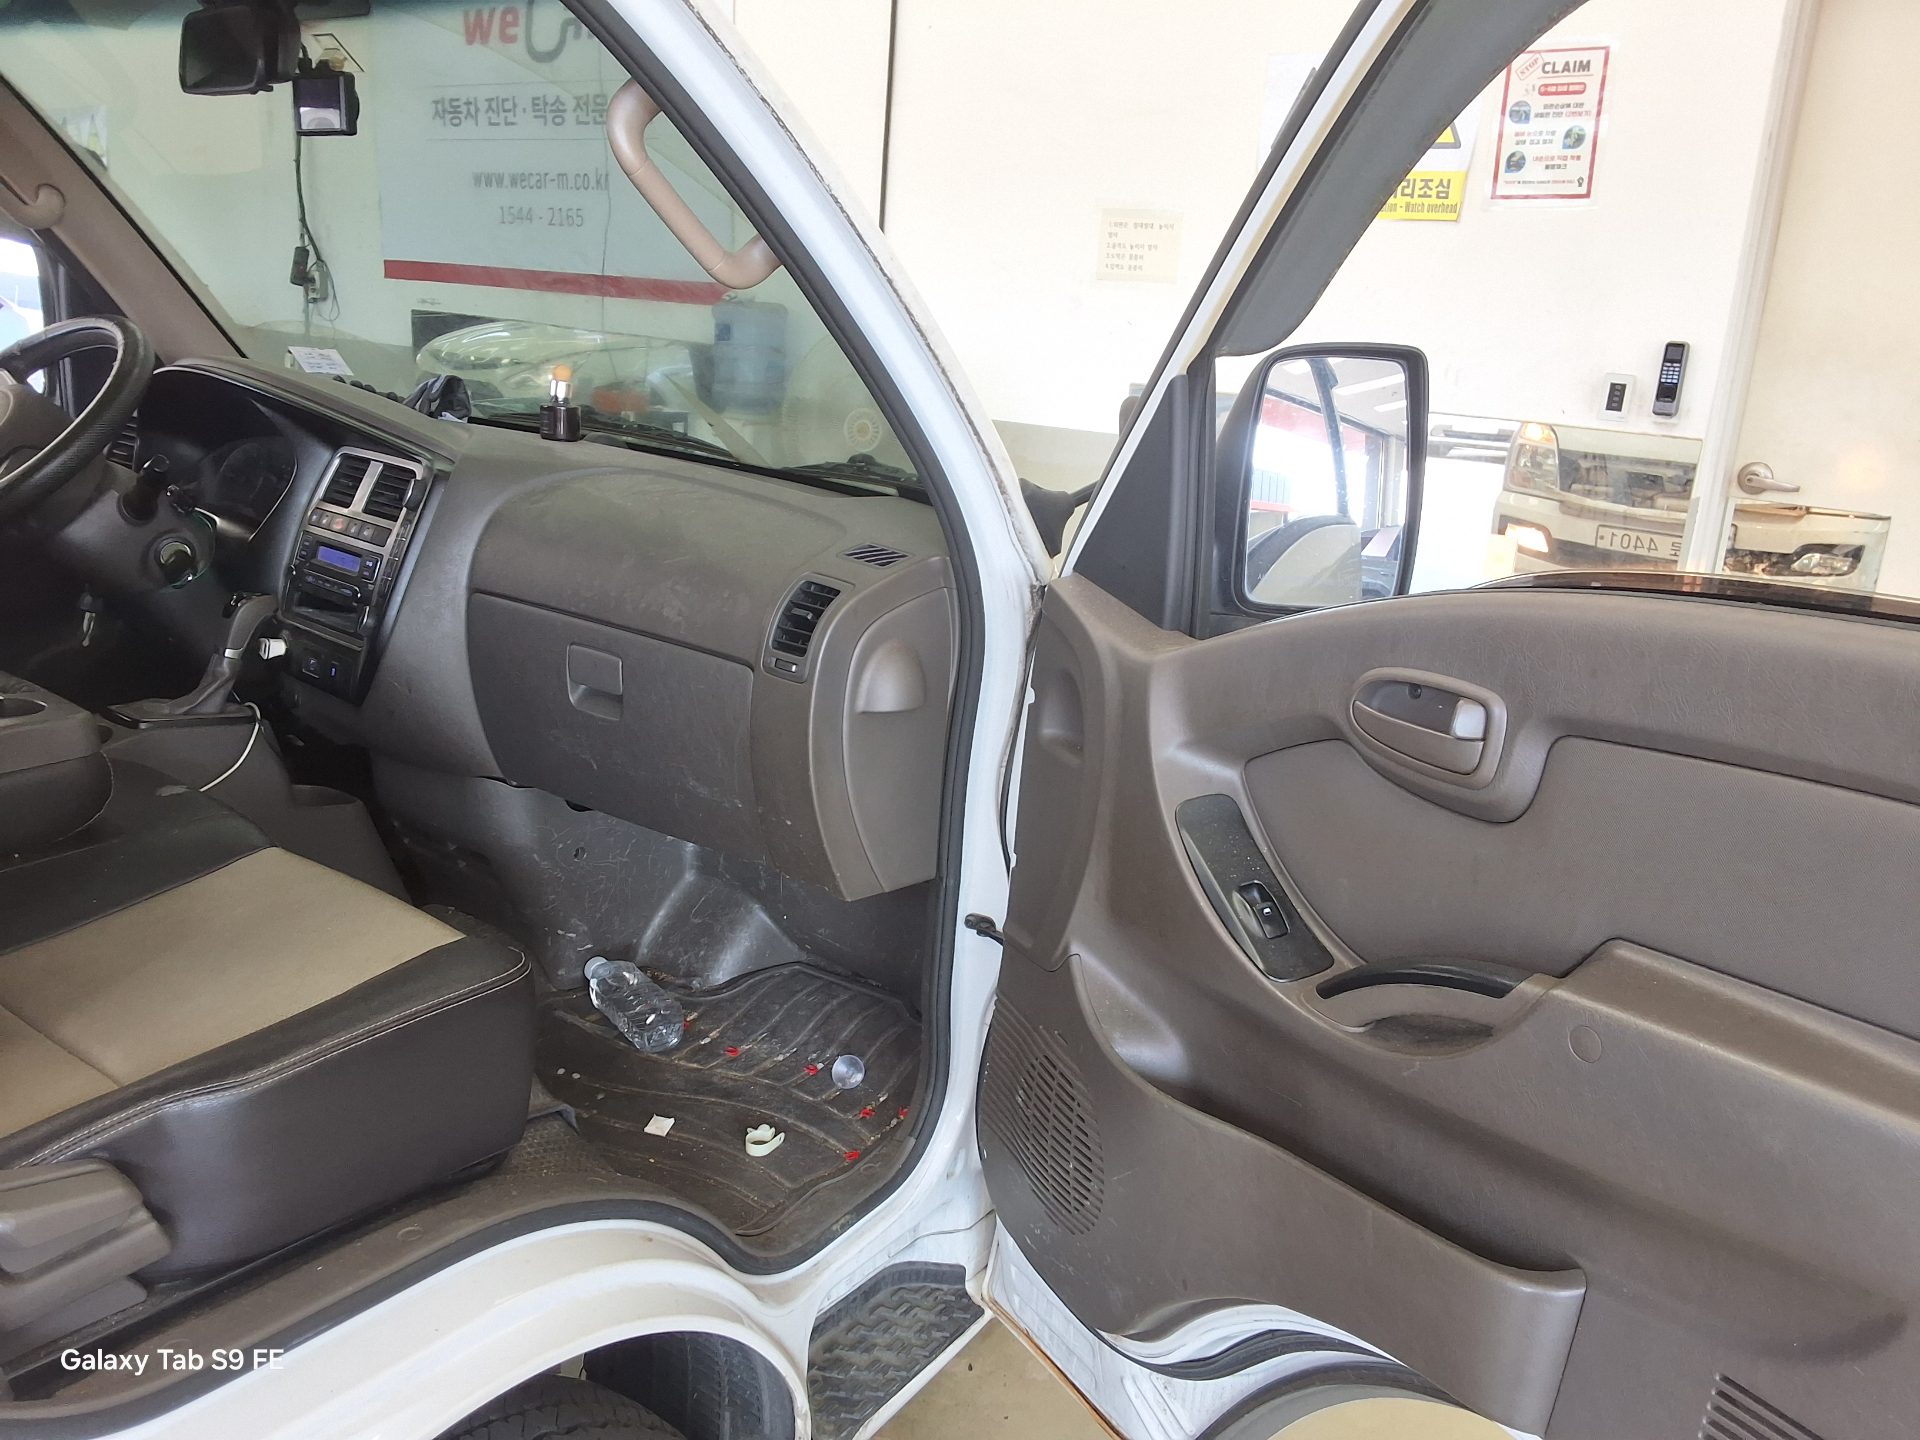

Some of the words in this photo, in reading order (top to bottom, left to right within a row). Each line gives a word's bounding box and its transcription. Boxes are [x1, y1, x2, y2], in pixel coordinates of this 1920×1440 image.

[1541, 59, 1592, 74] CLAIM
[432, 96, 480, 128] 자동차
[572, 93, 608, 126] 전문
[472, 168, 609, 191] www.wecar-m.co.kr
[1405, 201, 1425, 213] Watch
[1426, 202, 1458, 214] overhead
